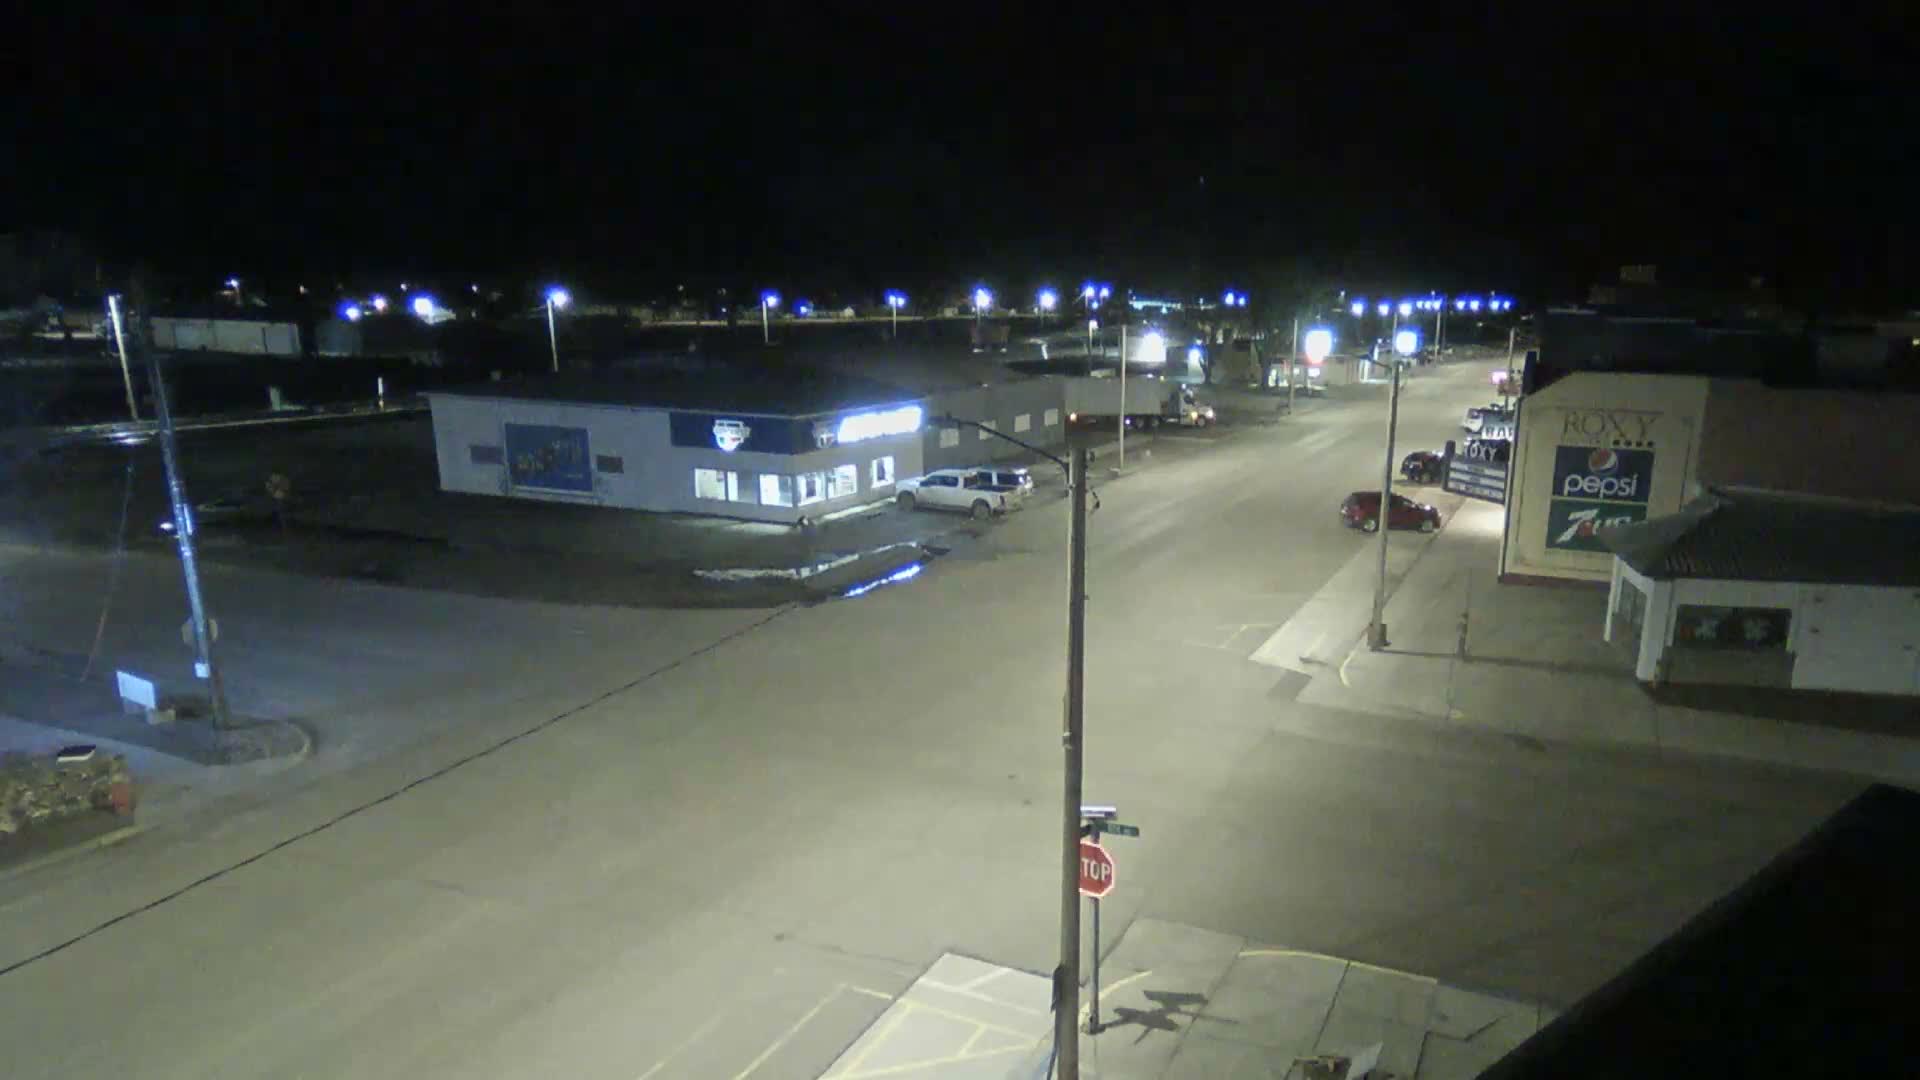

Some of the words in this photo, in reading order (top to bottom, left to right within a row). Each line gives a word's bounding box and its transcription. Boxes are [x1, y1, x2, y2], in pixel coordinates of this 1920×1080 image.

[1563, 411, 1657, 437] ROXY
[1564, 473, 1638, 499] pepsi
[1080, 858, 1111, 881] TOP
